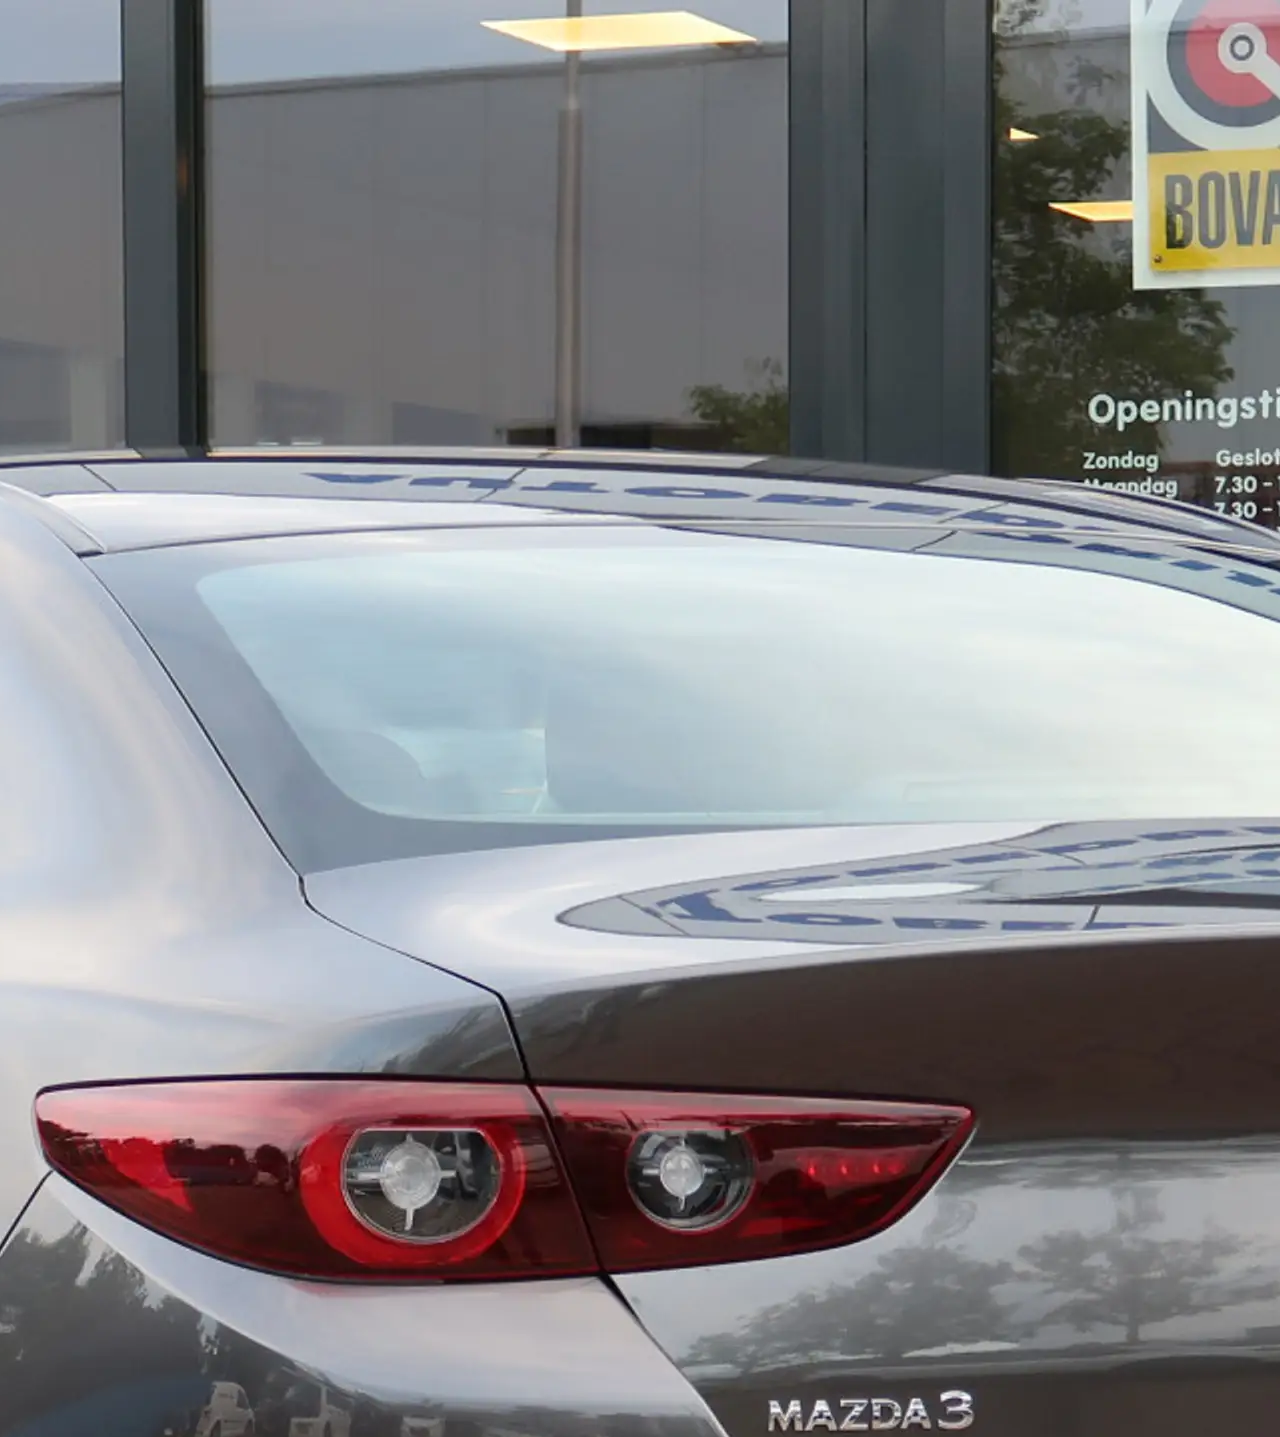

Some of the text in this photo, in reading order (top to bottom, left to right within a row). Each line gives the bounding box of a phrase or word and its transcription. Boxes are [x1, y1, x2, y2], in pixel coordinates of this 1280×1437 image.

[1083, 452, 1159, 472] Zondag
[1214, 476, 1257, 493] 7.30
[1214, 501, 1257, 518] 730
